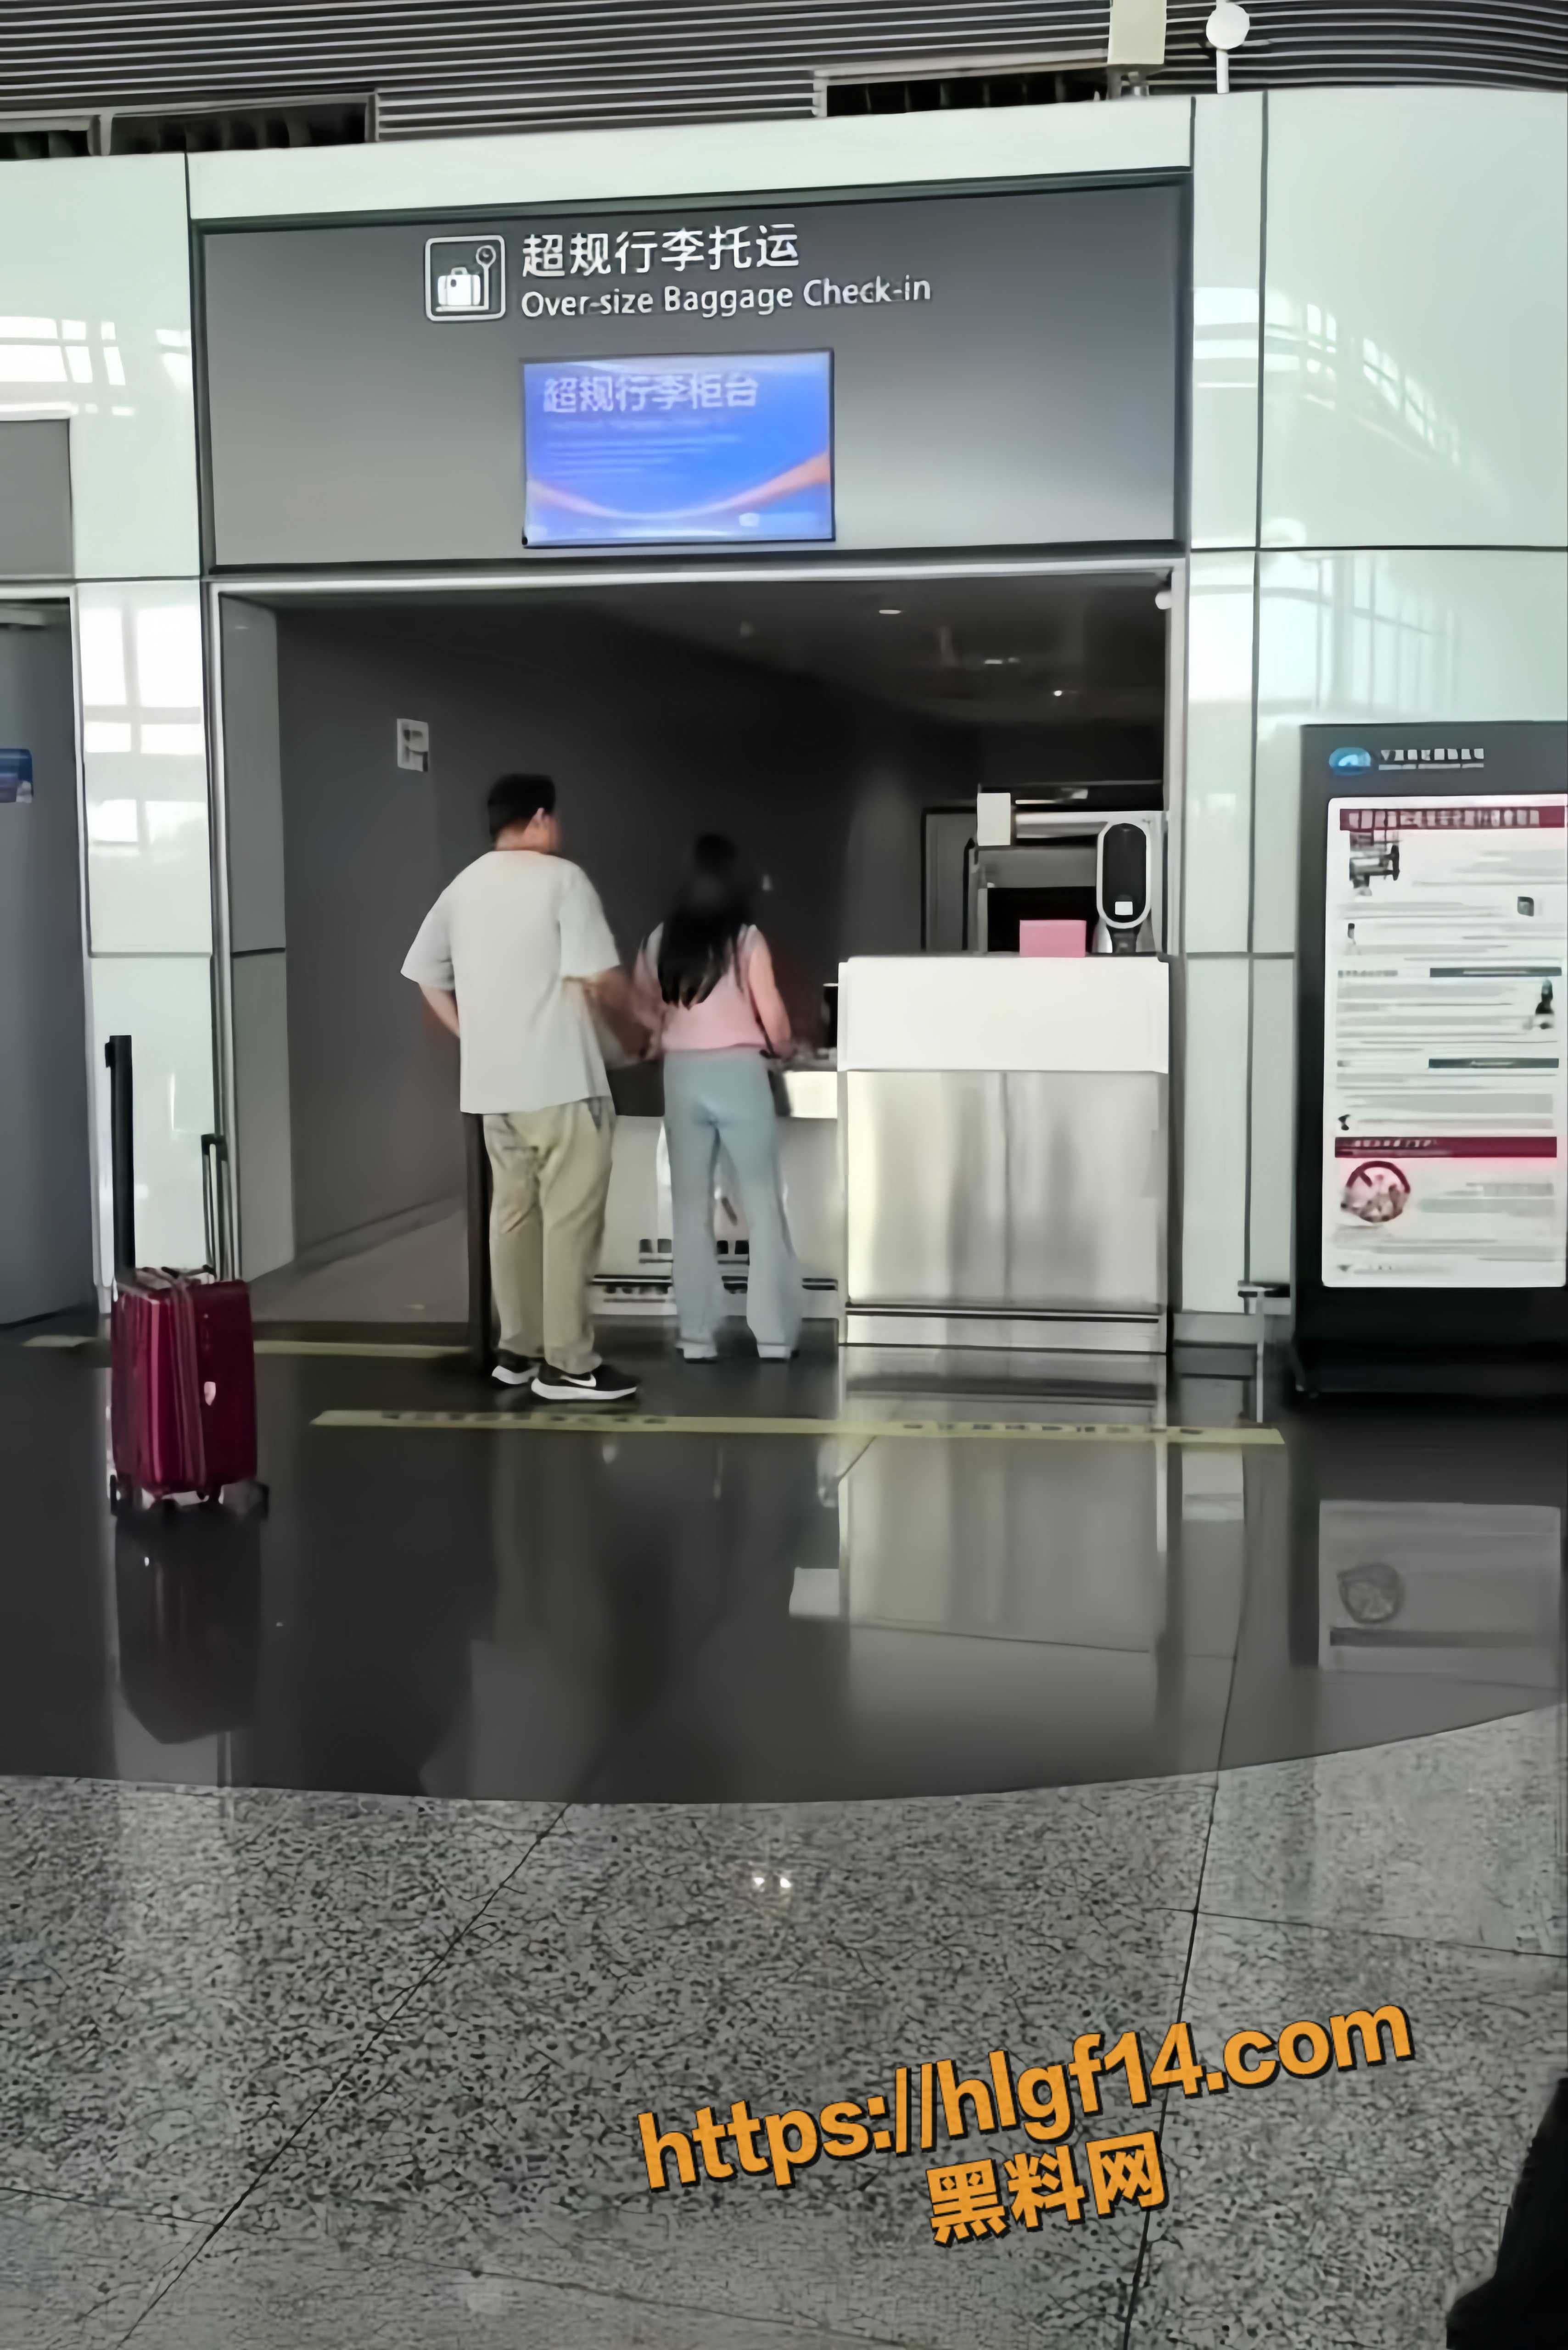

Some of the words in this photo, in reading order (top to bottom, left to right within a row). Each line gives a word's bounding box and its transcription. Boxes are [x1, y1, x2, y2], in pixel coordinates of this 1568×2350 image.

[522, 224, 799, 277] 超规行李托运
[521, 289, 653, 318] Over-size
[664, 285, 793, 318] Baggage
[803, 274, 931, 307] Check-in
[543, 372, 759, 413] 超规行李柜台
